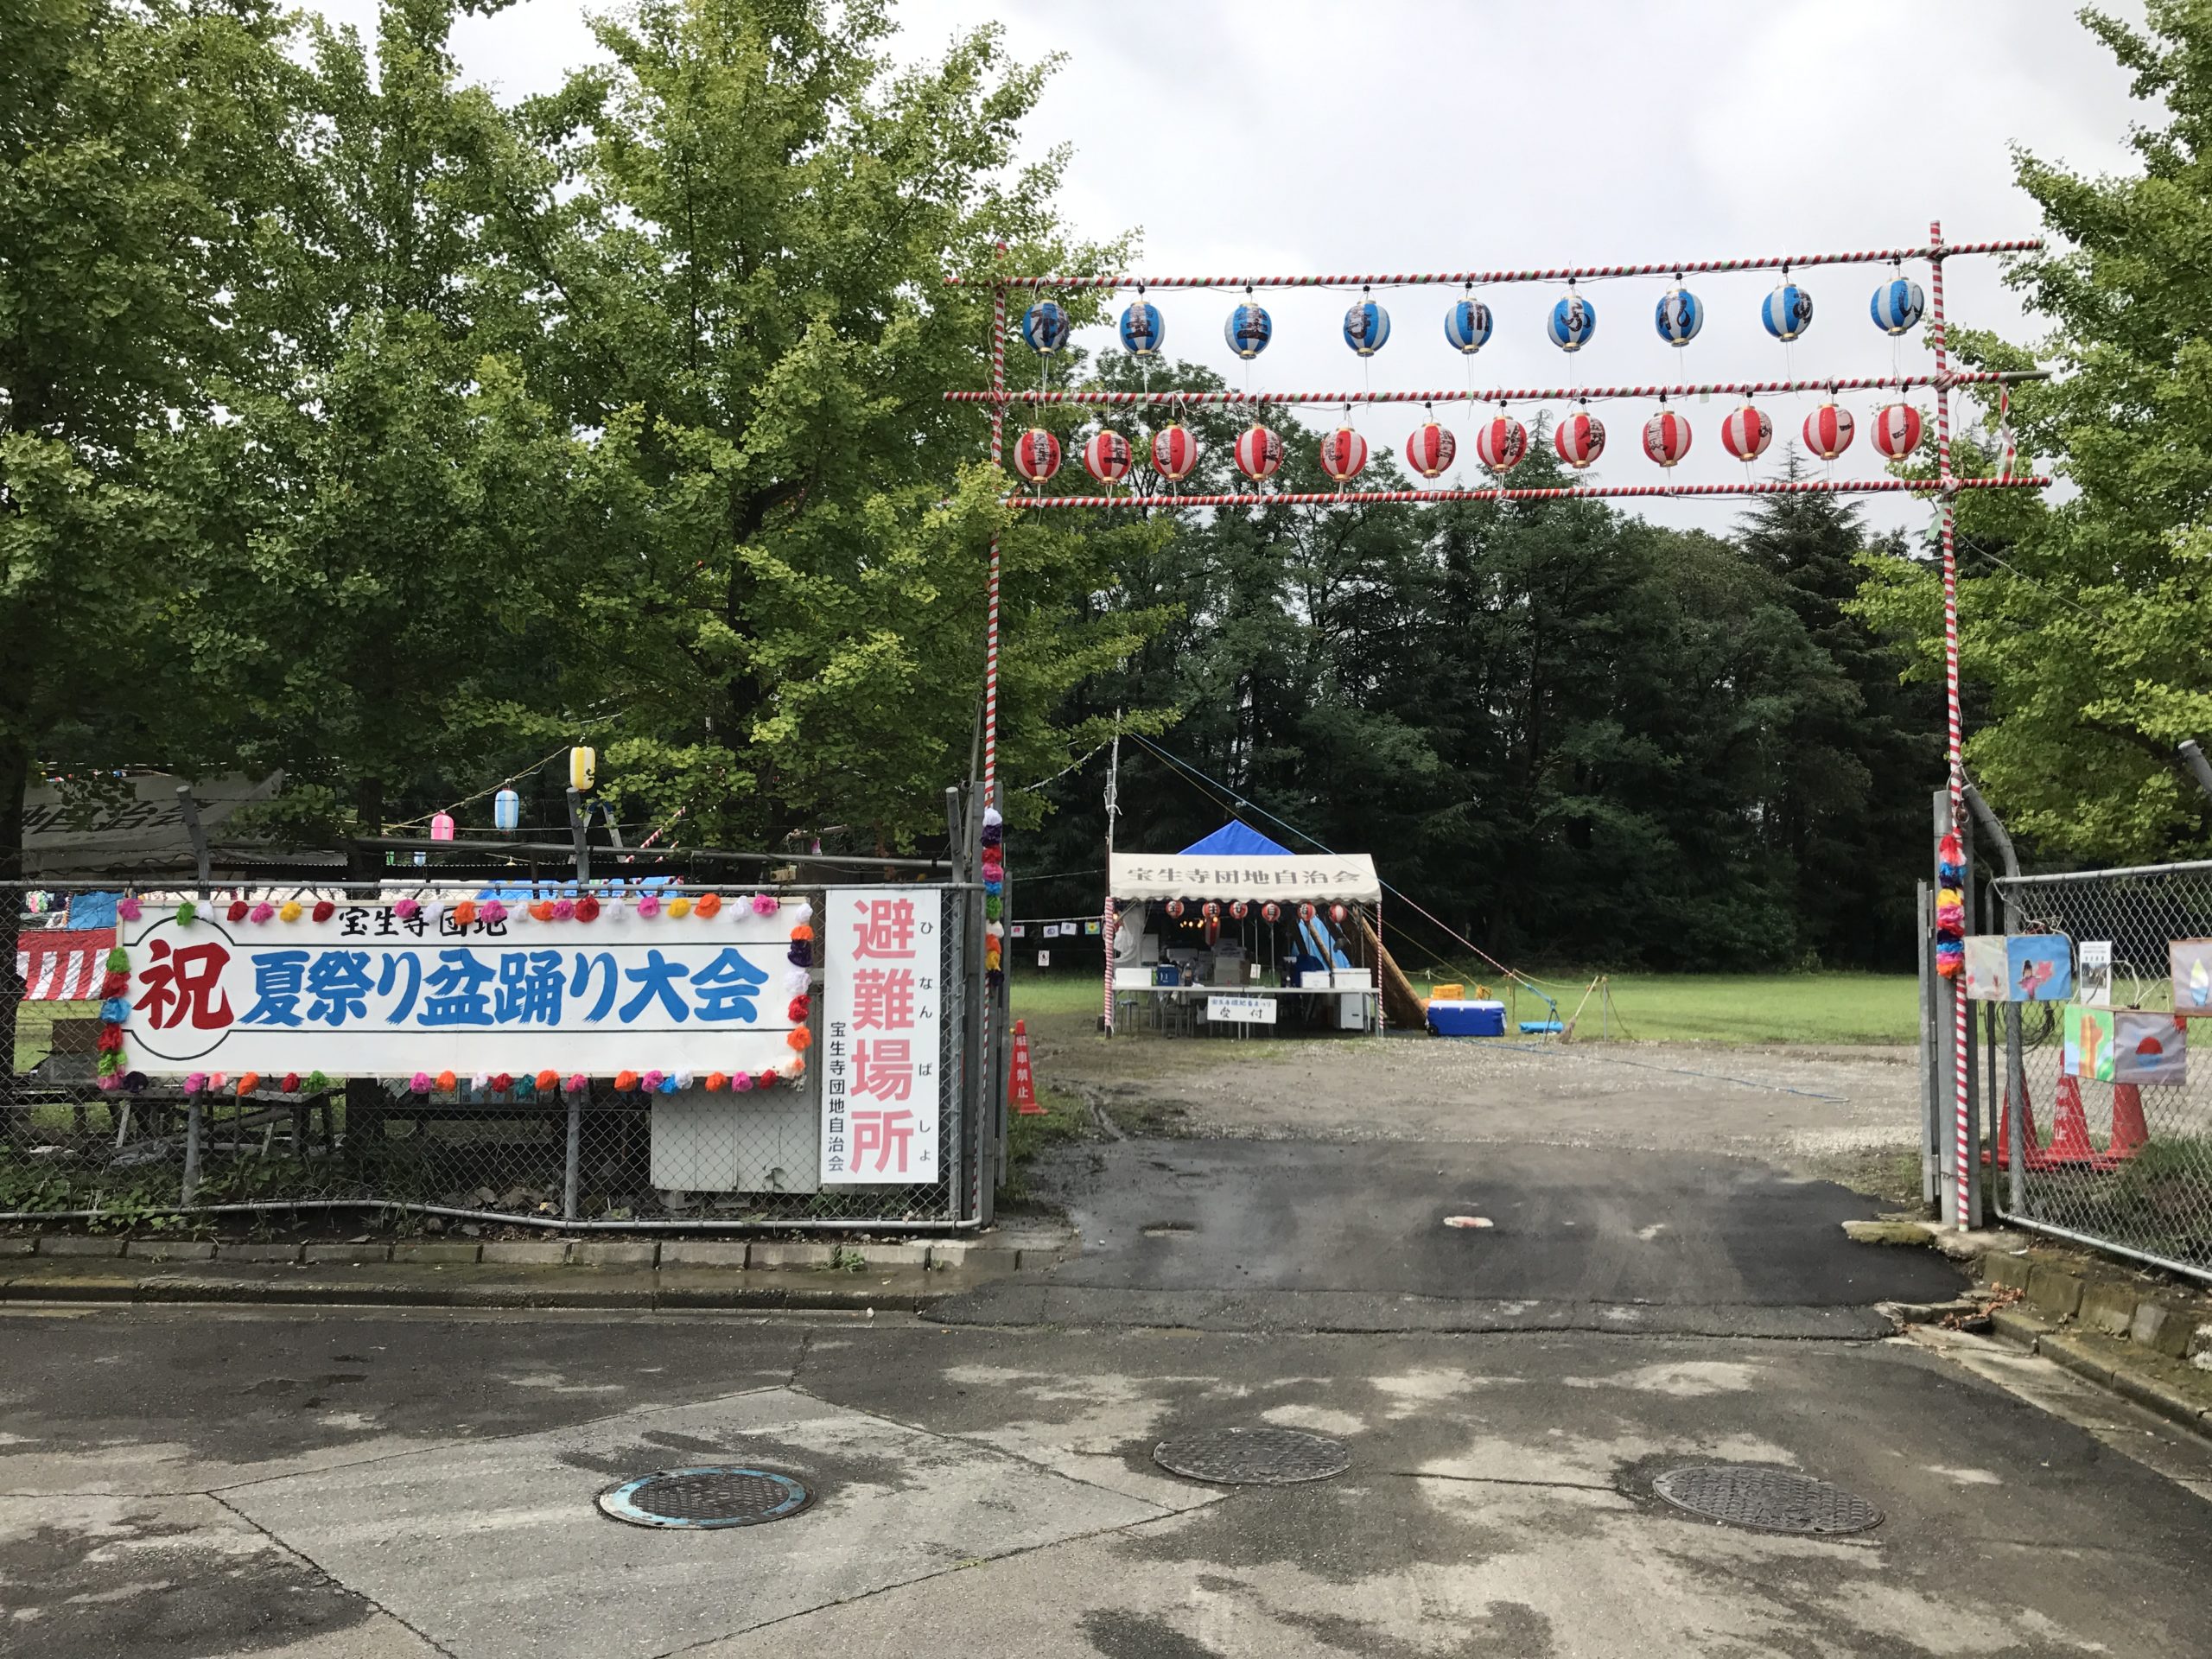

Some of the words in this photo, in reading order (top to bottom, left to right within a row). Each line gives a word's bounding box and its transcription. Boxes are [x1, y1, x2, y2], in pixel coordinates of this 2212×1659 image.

[1127, 867, 1361, 885] 宝生寺団地自治会
[132, 939, 236, 1031] 祝
[239, 947, 770, 1027] 夏祭り盆踊り大会
[849, 898, 916, 1174] 避難場所
[1015, 1035, 1030, 1099] 駐車禁止
[828, 1021, 846, 1173] 宝生寺団地自治会
